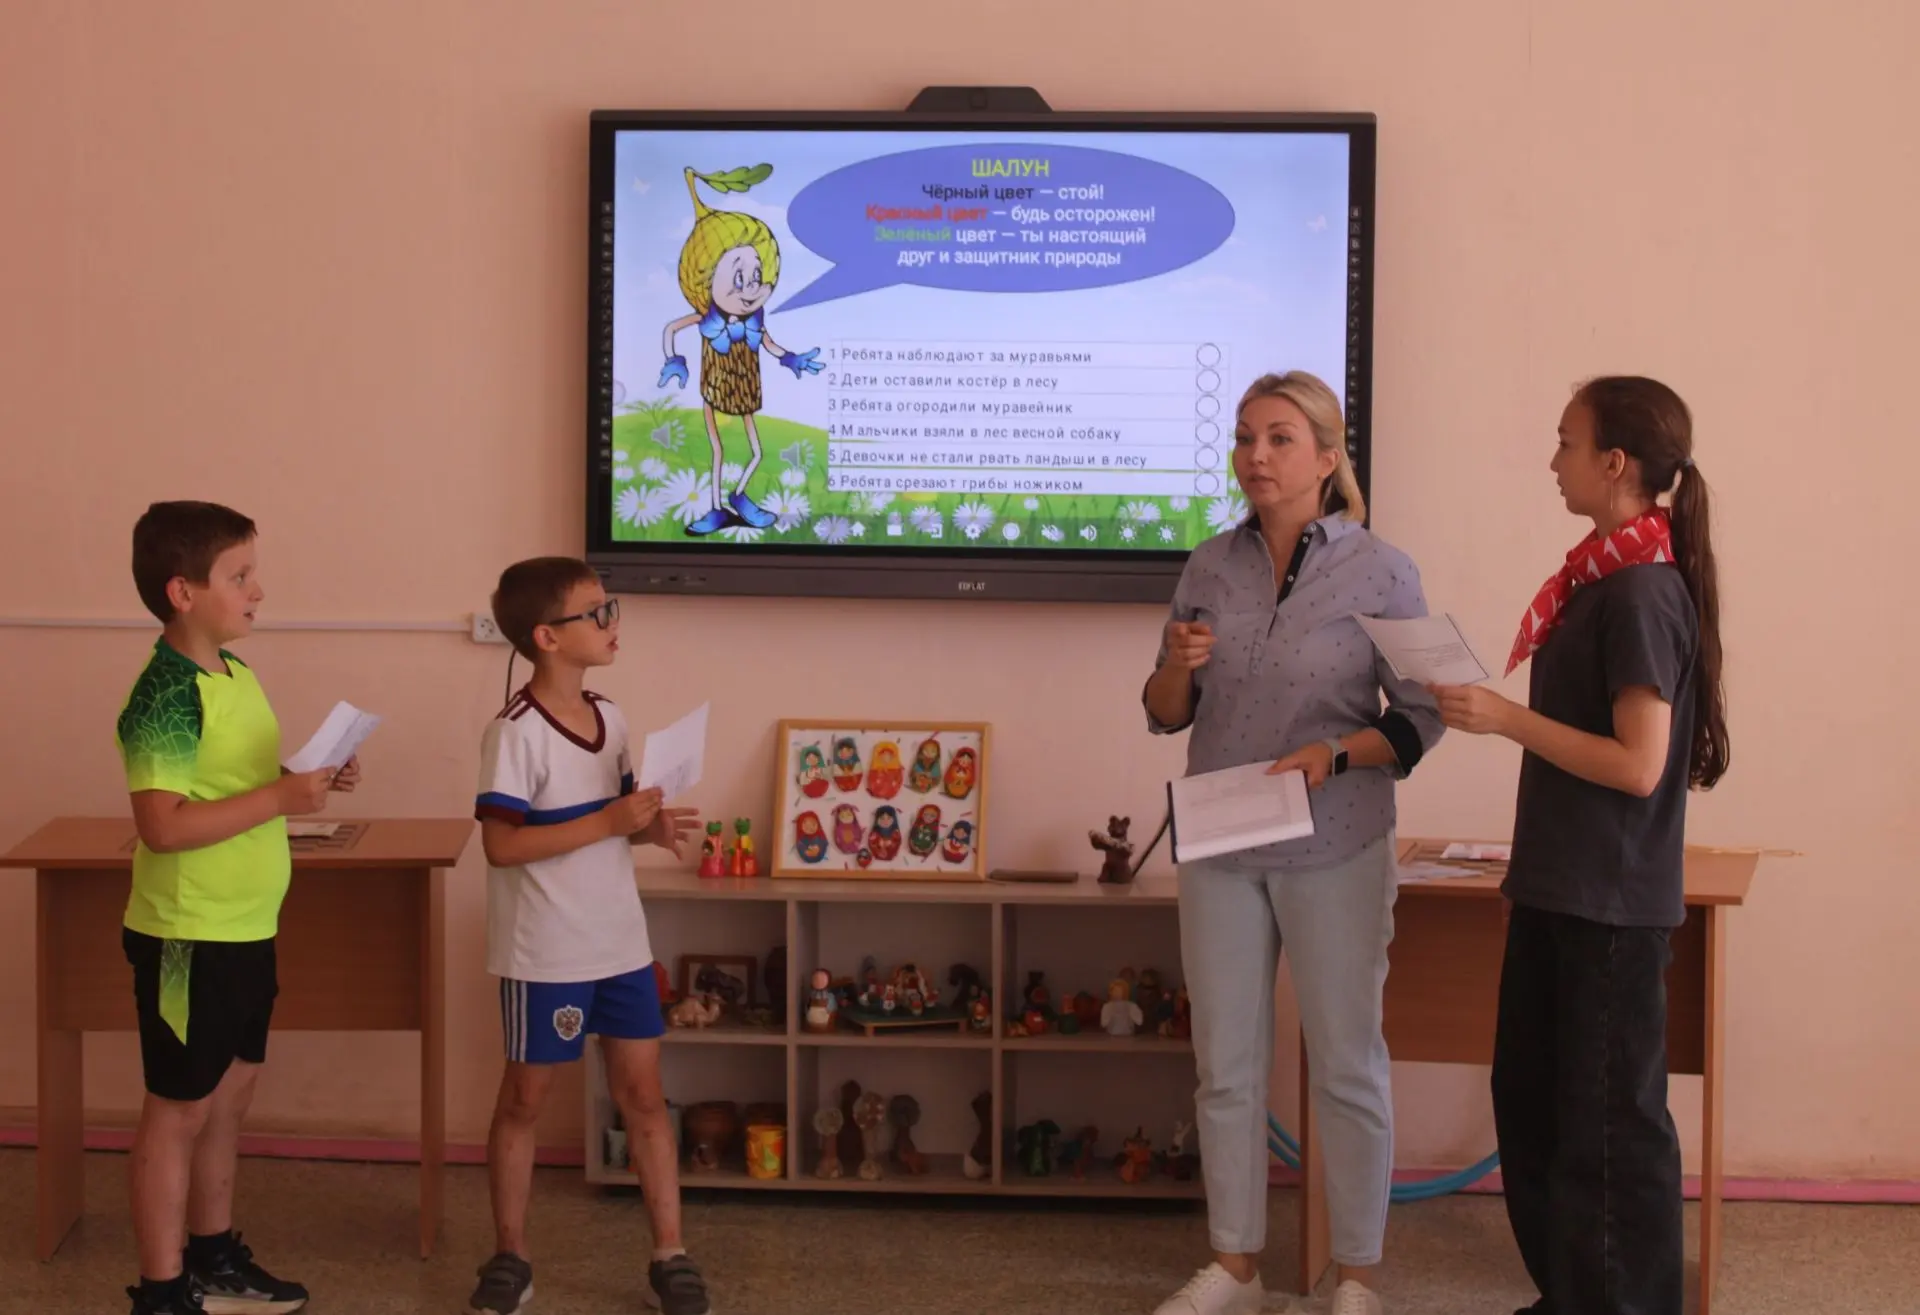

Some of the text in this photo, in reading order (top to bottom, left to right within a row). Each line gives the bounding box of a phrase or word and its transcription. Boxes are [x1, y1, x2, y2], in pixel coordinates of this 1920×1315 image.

[972, 159, 1050, 177] ШАЛУН
[922, 183, 989, 202] Чёрный
[994, 187, 1034, 203] цвет
[1058, 183, 1104, 200] стой!
[1011, 205, 1051, 225] будь
[1054, 206, 1156, 225] осторожен!
[956, 229, 996, 244] цвет
[1020, 230, 1044, 243] ты
[1048, 227, 1147, 246] настоящий
[897, 250, 1122, 268] друг и защитник природы
[829, 348, 1092, 365] 1 Ребята наблюдают за муравьями
[828, 372, 1059, 391] 2 Дети оставили костёр в лесу
[828, 399, 1073, 415] 3 Ребята огородили муравейник
[828, 423, 836, 436] 4
[923, 427, 965, 438] взяли
[970, 427, 979, 438] в
[984, 427, 1009, 439] лес
[1012, 426, 1065, 439] весной
[1070, 427, 1121, 442] собаку
[828, 449, 1148, 469] 5 Девочки не стали рвать ландыши в лесу
[828, 474, 1083, 490] 6 Ребята срезают грибы ножиком
